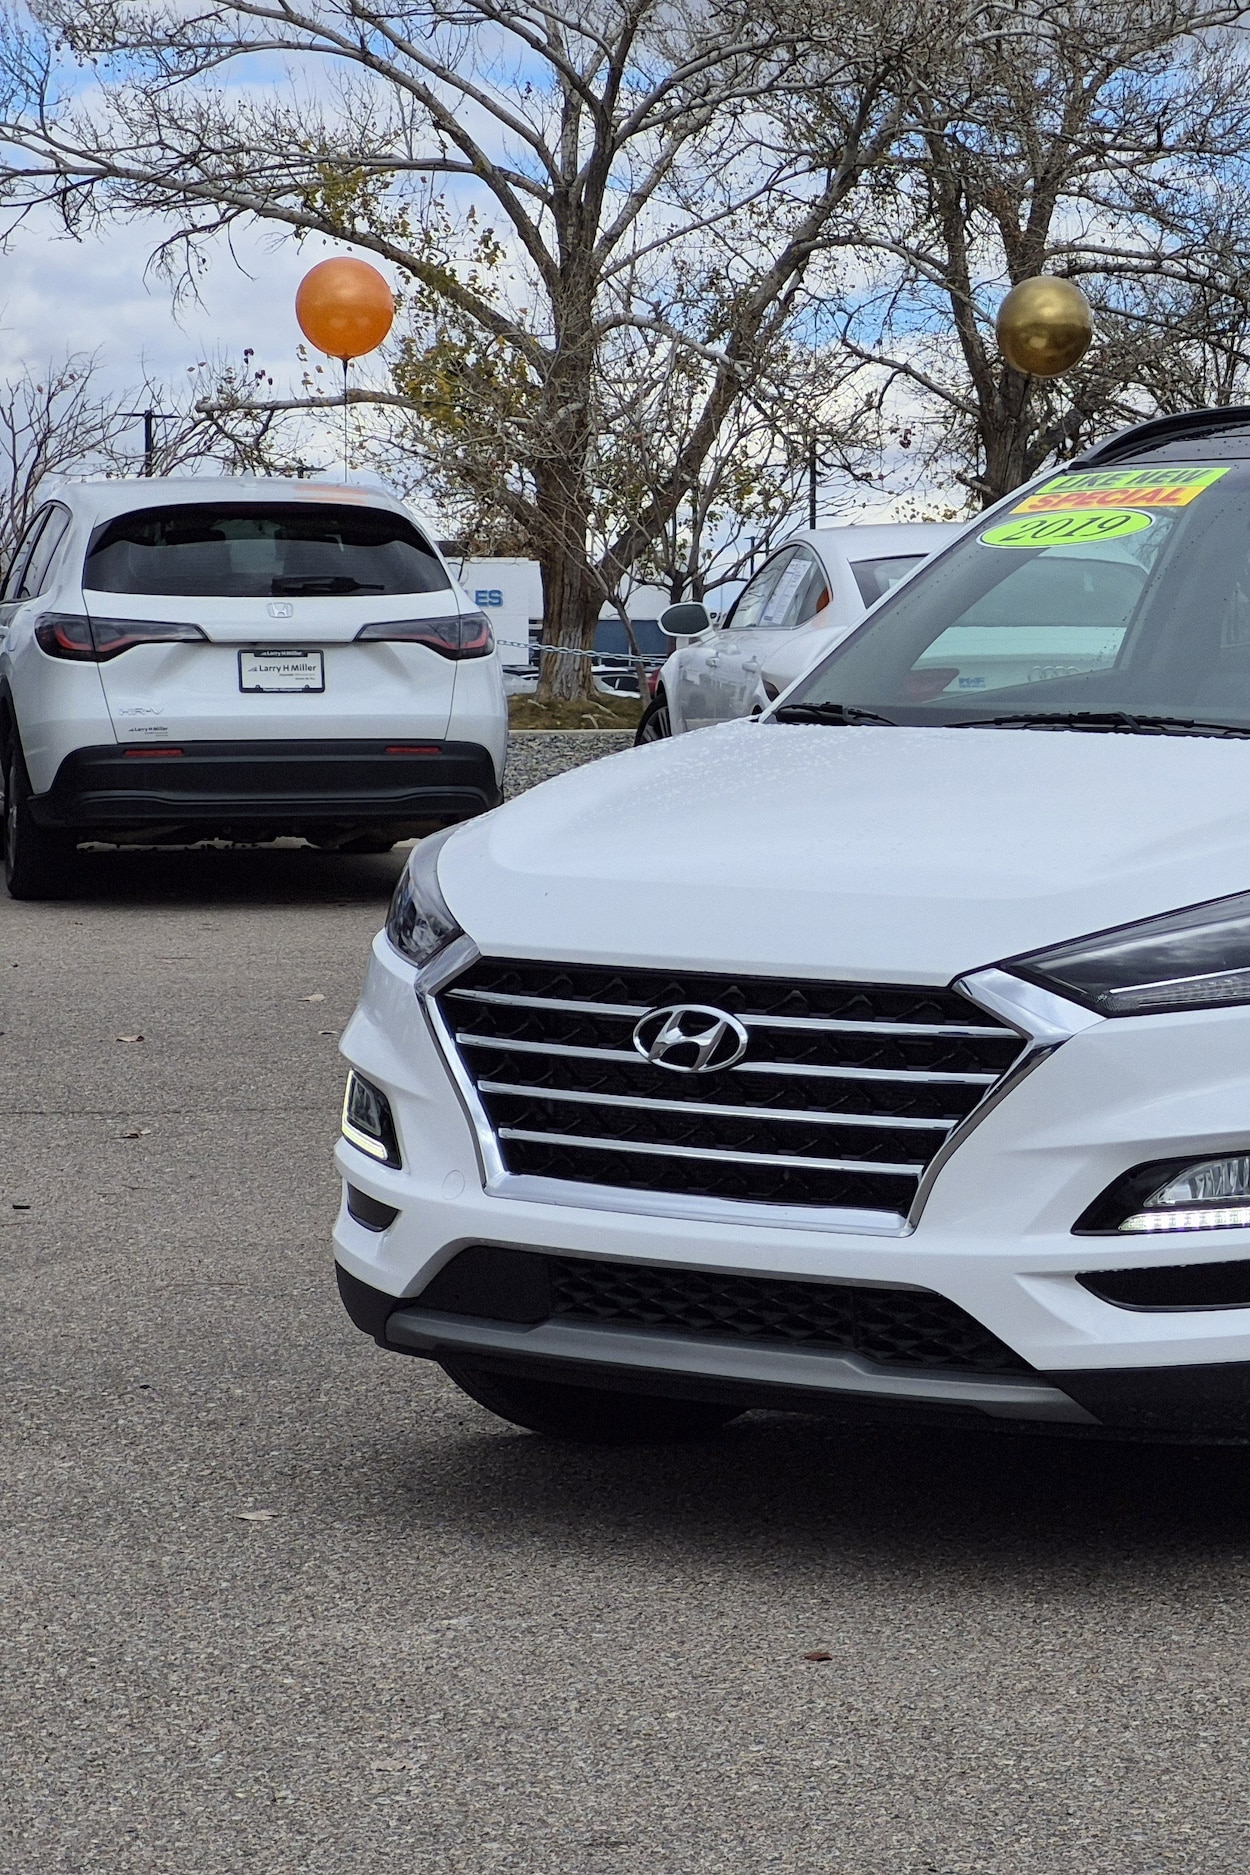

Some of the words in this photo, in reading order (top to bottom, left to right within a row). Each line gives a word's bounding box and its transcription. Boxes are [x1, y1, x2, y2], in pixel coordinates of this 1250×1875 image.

[1055, 472, 1127, 490] LIKE
[1124, 468, 1212, 486] NEW
[1028, 487, 1184, 510] SPECIAL
[998, 514, 1132, 542] 2019
[259, 664, 281, 673] Larry
[290, 663, 317, 671] Miller
